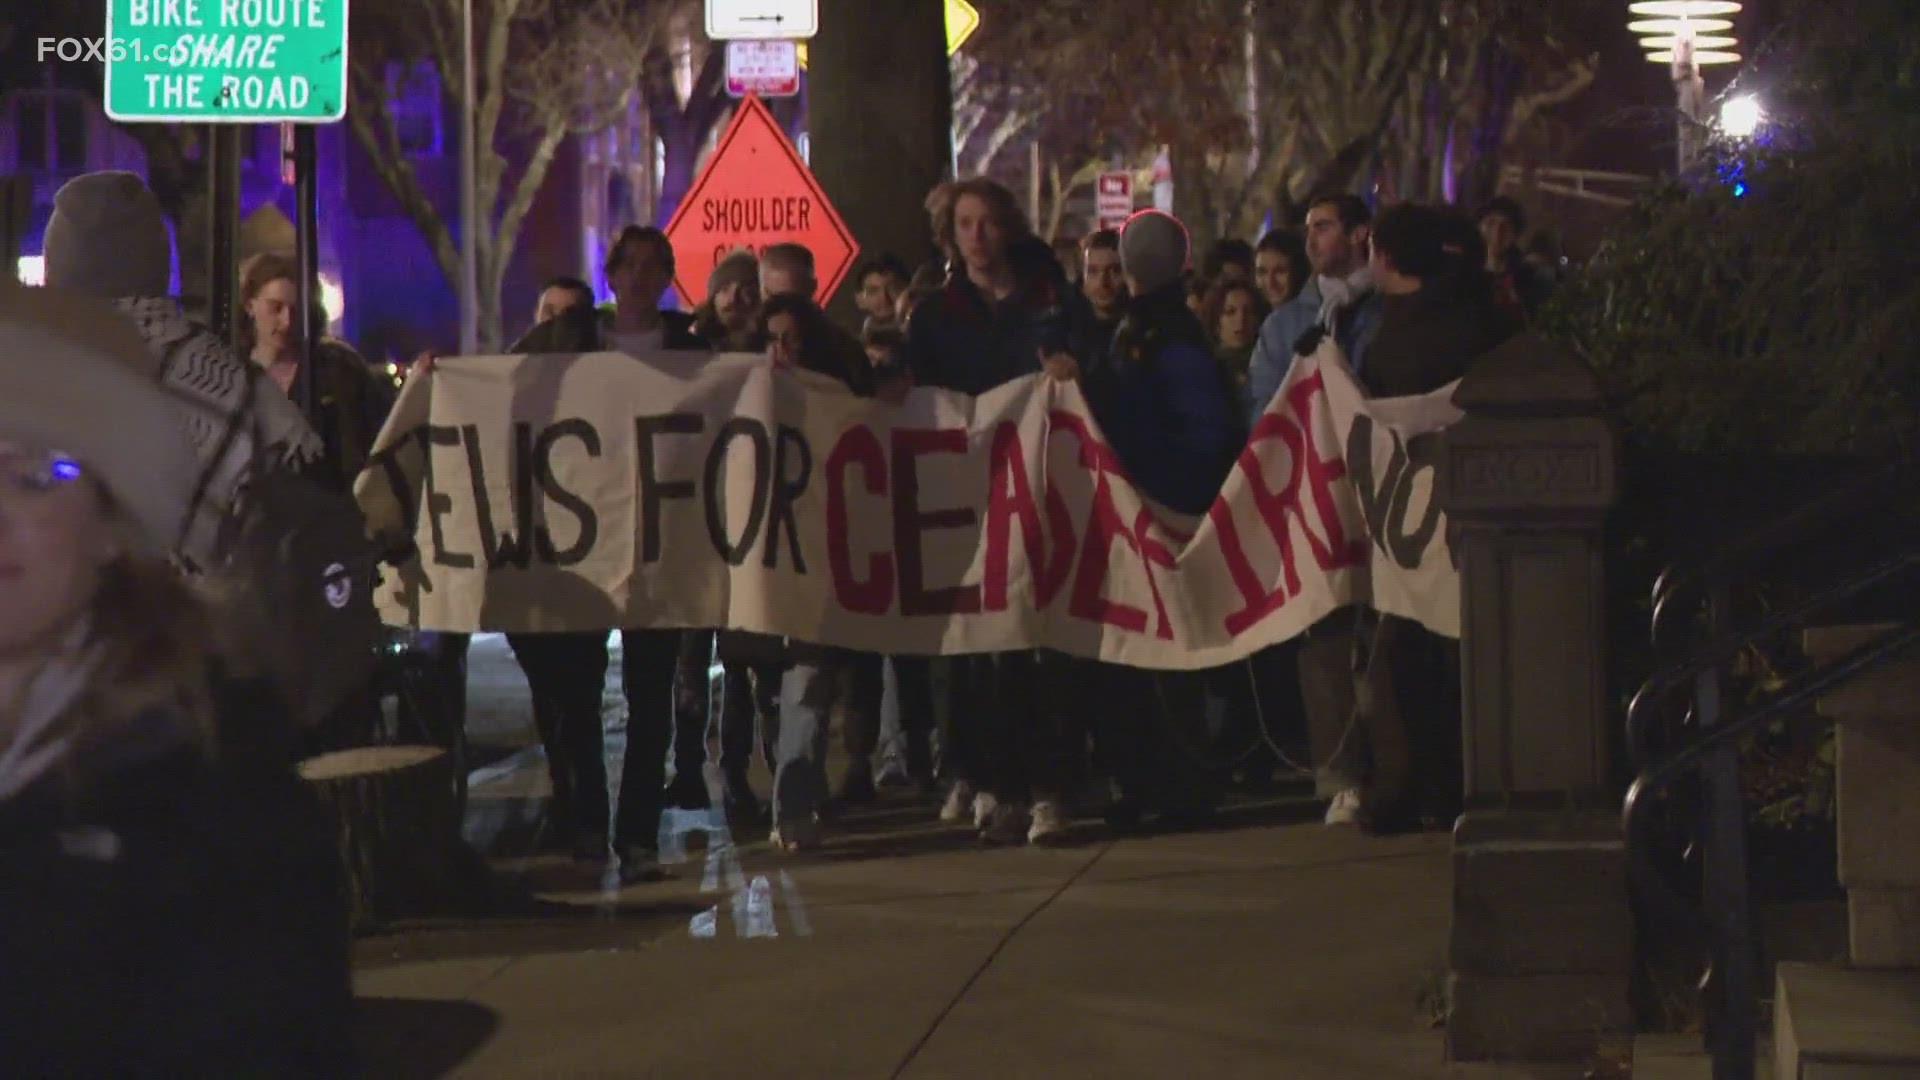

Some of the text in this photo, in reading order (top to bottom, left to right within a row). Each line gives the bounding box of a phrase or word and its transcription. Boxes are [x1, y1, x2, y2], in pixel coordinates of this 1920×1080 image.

[129, 0, 326, 27] BIKE ROUTE
[168, 34, 285, 68] SHARE
[144, 74, 310, 109] THE ROAD
[702, 196, 811, 232] SHOULDER
[635, 413, 809, 574] FOR
[1346, 413, 1458, 571] NO
